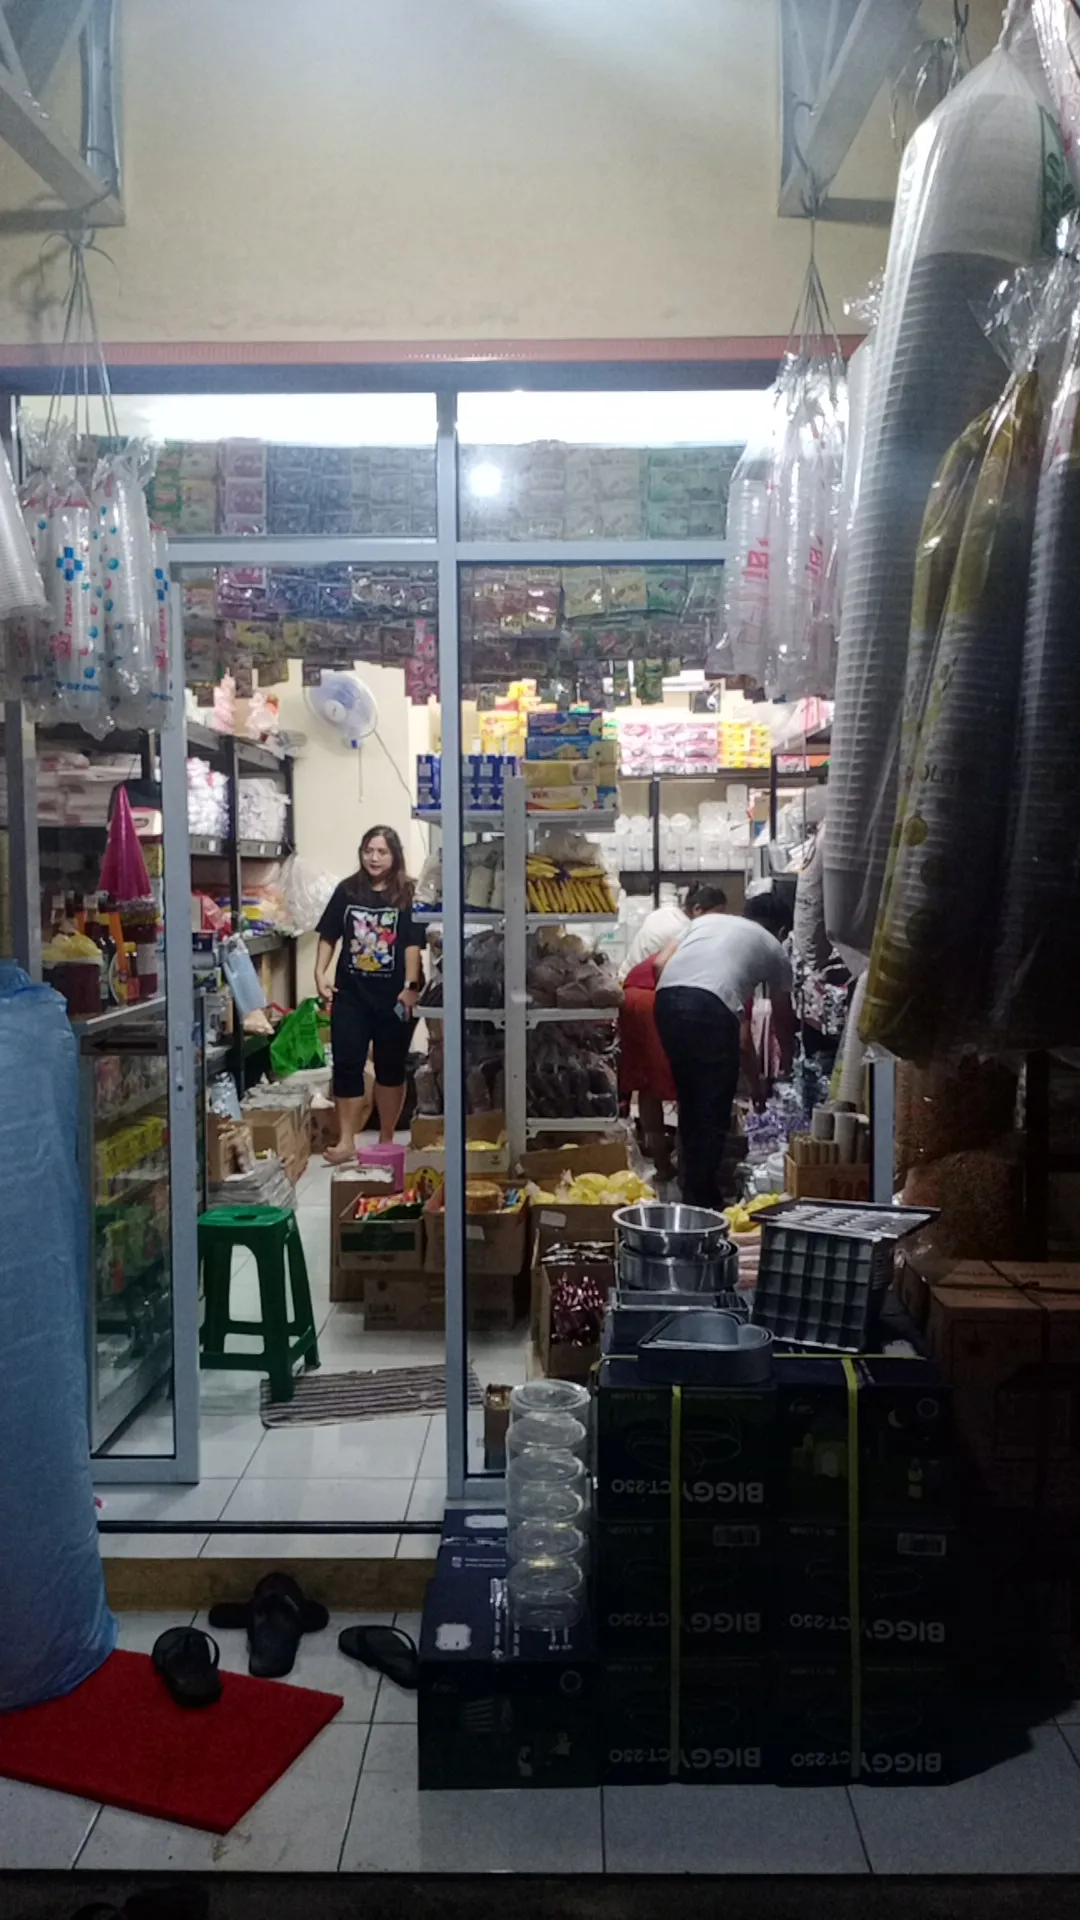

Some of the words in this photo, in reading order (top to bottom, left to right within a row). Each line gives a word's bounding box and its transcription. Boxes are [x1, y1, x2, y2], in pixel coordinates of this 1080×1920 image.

[611, 1479, 671, 1494] CT-250
[608, 1612, 670, 1627] CT-250
[789, 1613, 850, 1630] CT-250
[609, 1749, 670, 1762] CT-250
[790, 1752, 850, 1767] CT-250
